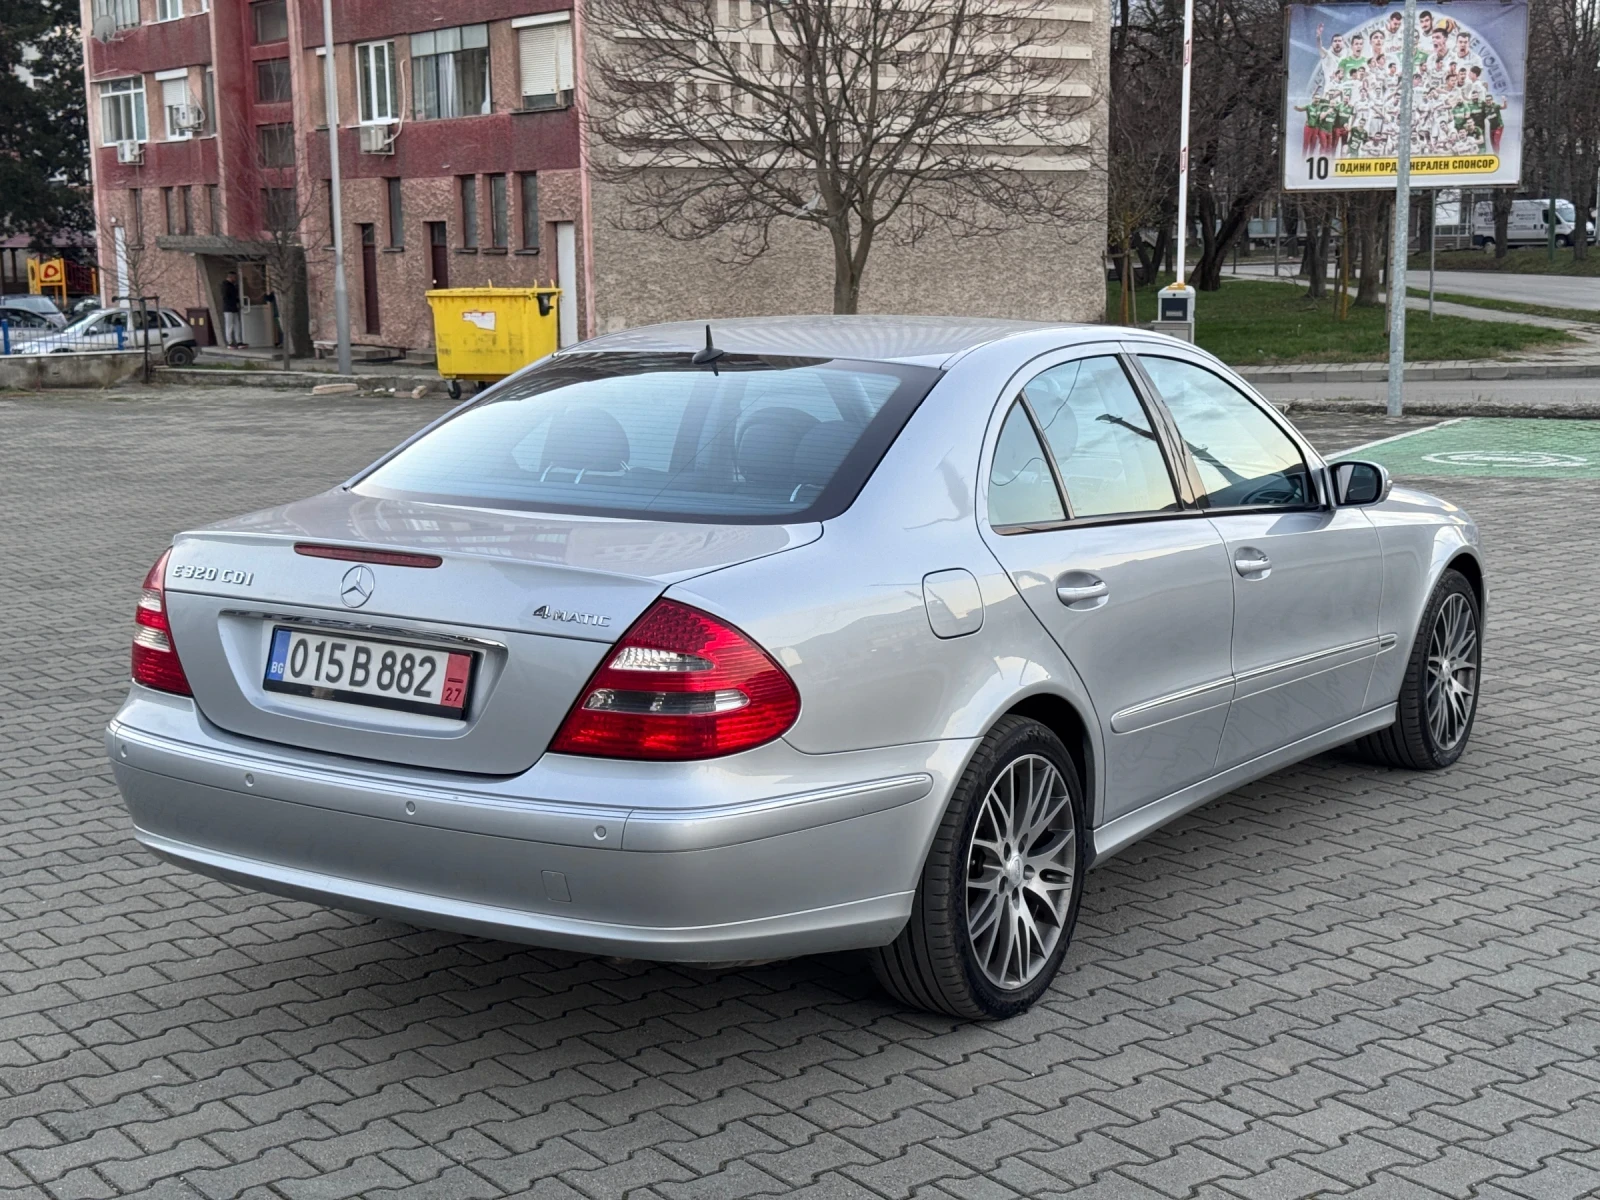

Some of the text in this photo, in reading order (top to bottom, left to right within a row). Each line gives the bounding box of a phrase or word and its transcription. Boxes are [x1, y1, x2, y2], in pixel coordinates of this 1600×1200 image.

[1306, 156, 1329, 180] 10
[1334, 162, 1372, 174] ГОДИНИ
[1409, 160, 1450, 171] НЕРАЛЕН
[1452, 158, 1495, 170] СПОНСОР
[172, 564, 255, 586] E320 CDI
[532, 604, 612, 628] 4MATIC
[270, 661, 285, 674] BG
[445, 687, 462, 702] 27
